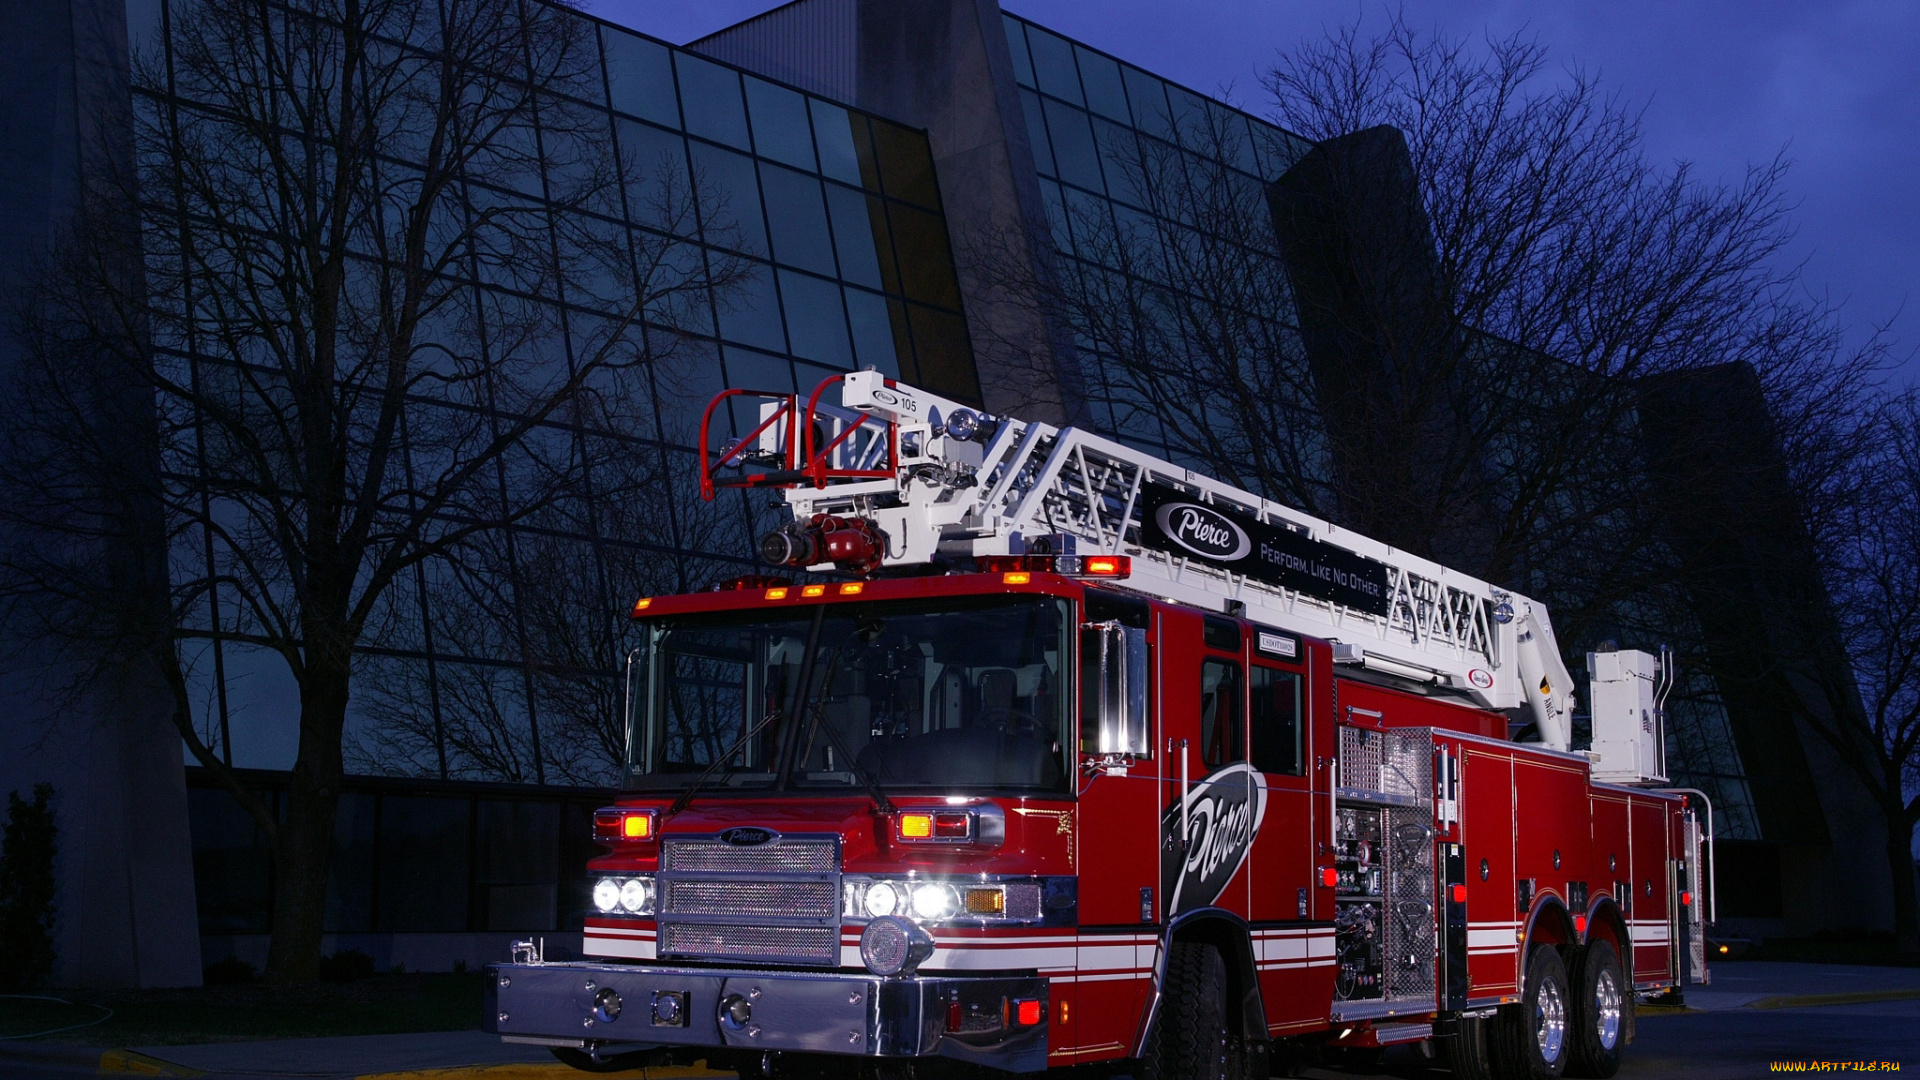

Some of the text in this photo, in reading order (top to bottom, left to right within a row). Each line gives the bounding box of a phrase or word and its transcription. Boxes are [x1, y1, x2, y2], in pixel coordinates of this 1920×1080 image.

[901, 397, 917, 413] 105
[1178, 508, 1231, 548] Pierce
[1311, 560, 1332, 581] LIKE
[1543, 697, 1556, 721] ANGLE
[728, 829, 765, 843] Pierce
[1170, 797, 1249, 909] Pierce
